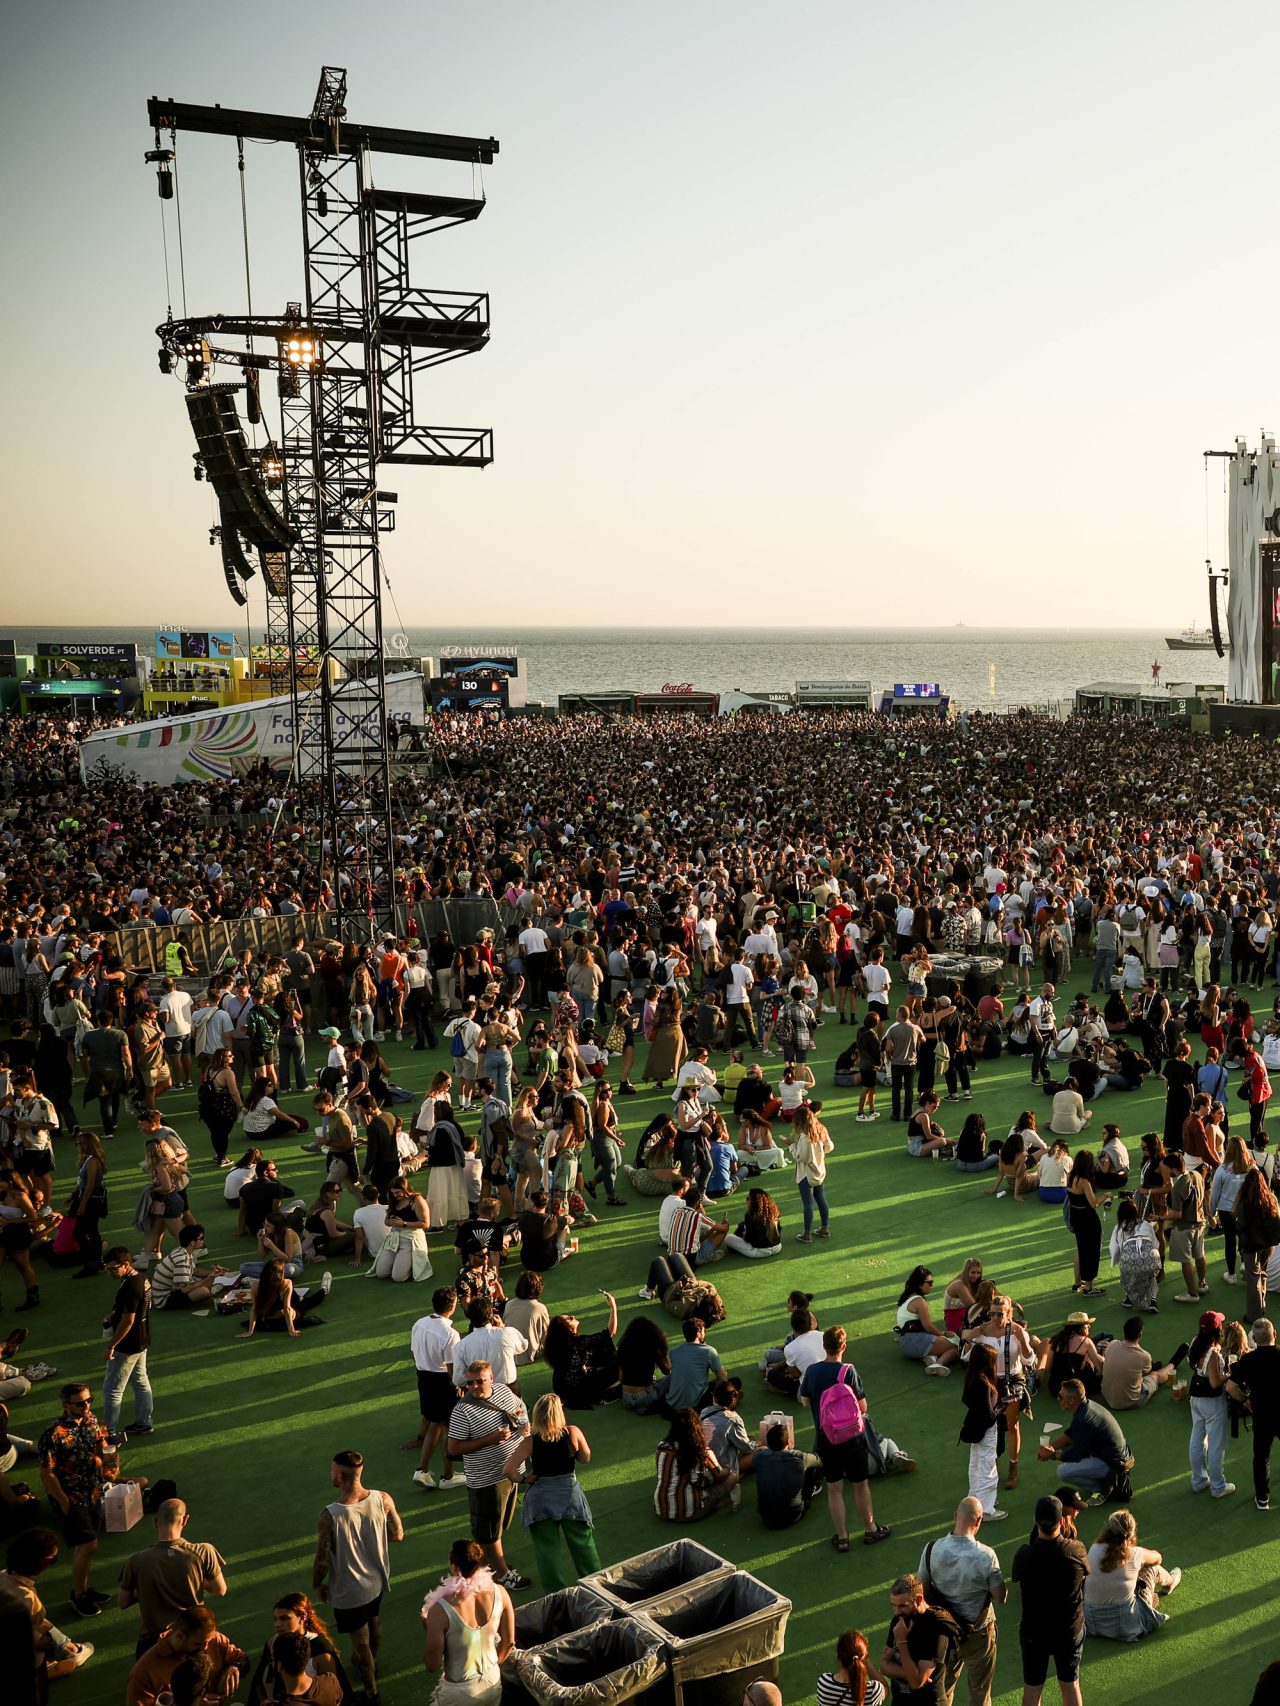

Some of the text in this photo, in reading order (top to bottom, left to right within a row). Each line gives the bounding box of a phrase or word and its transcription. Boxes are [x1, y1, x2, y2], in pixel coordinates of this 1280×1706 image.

[160, 623, 190, 632] fnac
[63, 646, 115, 654] SOLVERDE
[464, 646, 518, 657] HYUNDAI
[462, 681, 478, 690] i30
[336, 714, 346, 725] a
